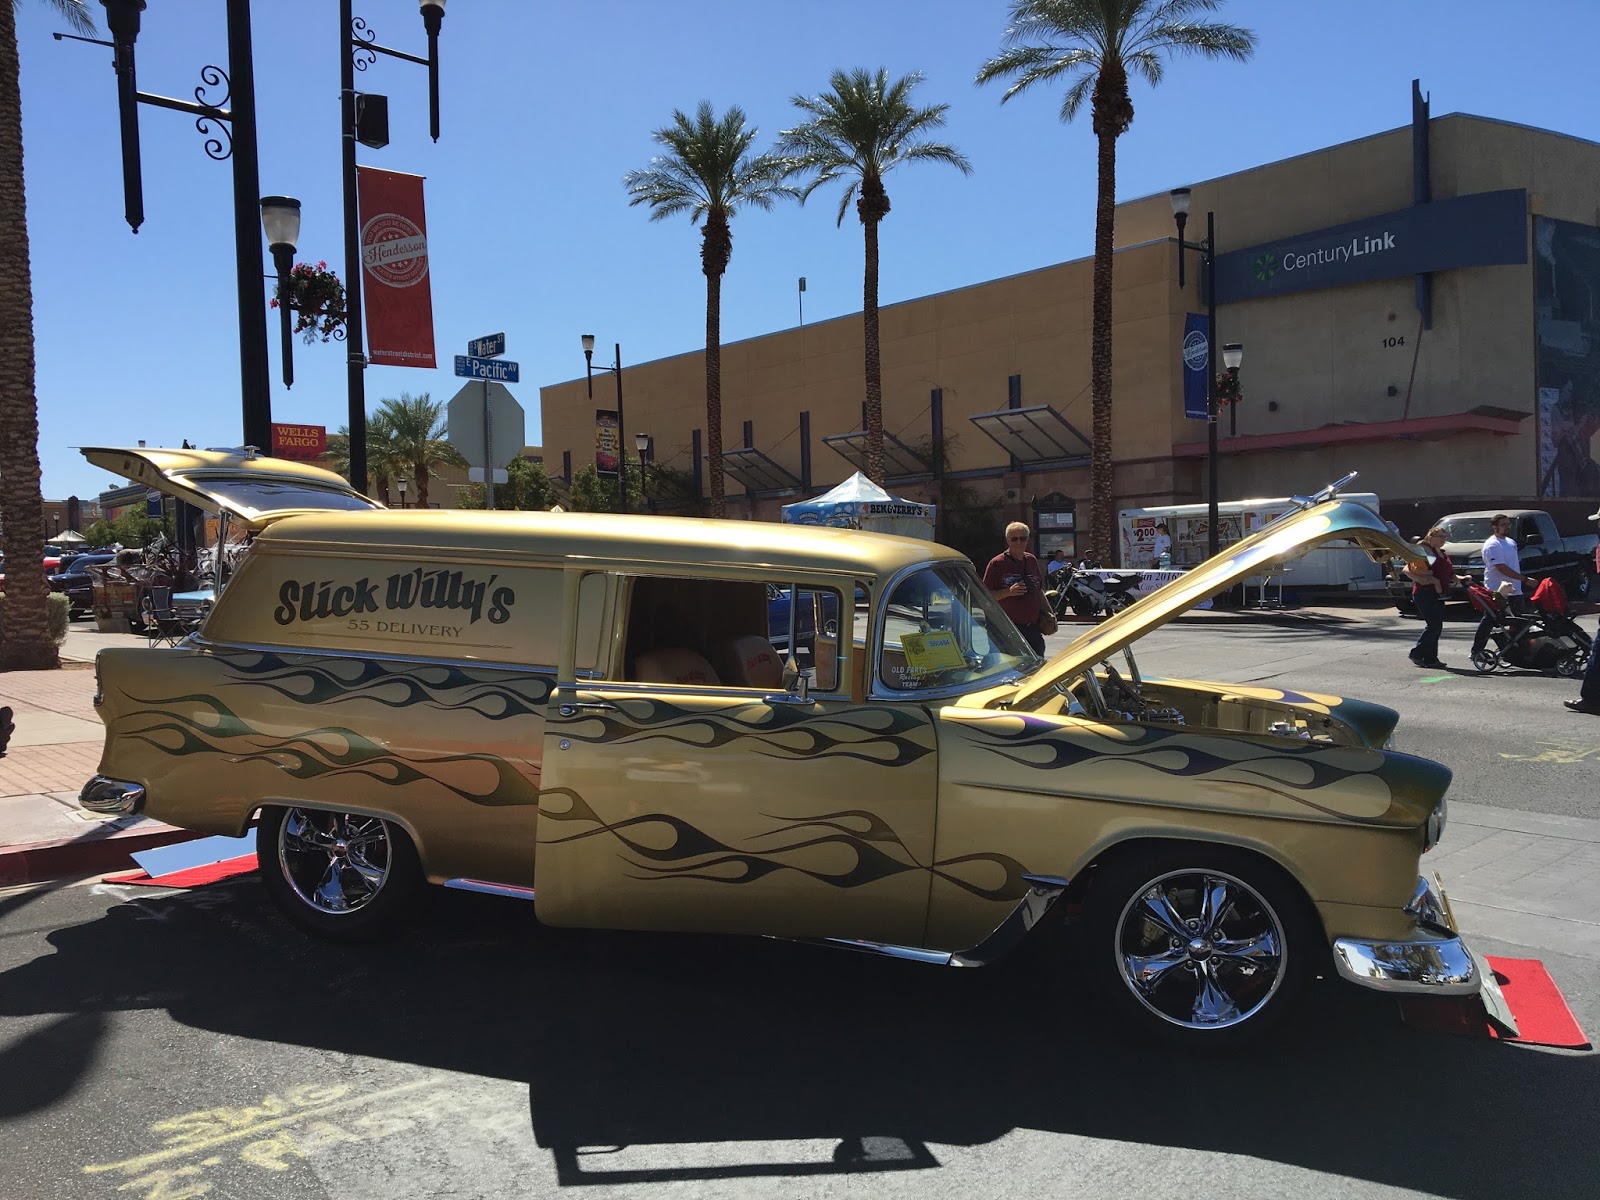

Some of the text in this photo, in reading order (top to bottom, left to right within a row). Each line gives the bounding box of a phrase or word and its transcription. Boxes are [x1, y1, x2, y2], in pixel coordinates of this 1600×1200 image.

[363, 241, 427, 264] Henderson
[1283, 231, 1396, 271] CenturyLink
[477, 339, 497, 357] Water
[497, 334, 503, 344] ST
[1382, 336, 1405, 348] 104
[373, 350, 433, 359] waterstreetdistrict.com
[466, 358, 471, 367] E
[472, 359, 508, 379] Pacific
[508, 363, 517, 372] AV
[276, 426, 319, 438] WELLS
[278, 436, 319, 447] FARGO
[274, 567, 515, 626] Slick Willy's
[347, 619, 464, 638] 55 DELIVERY
[891, 666, 928, 674] OLD FARTS
